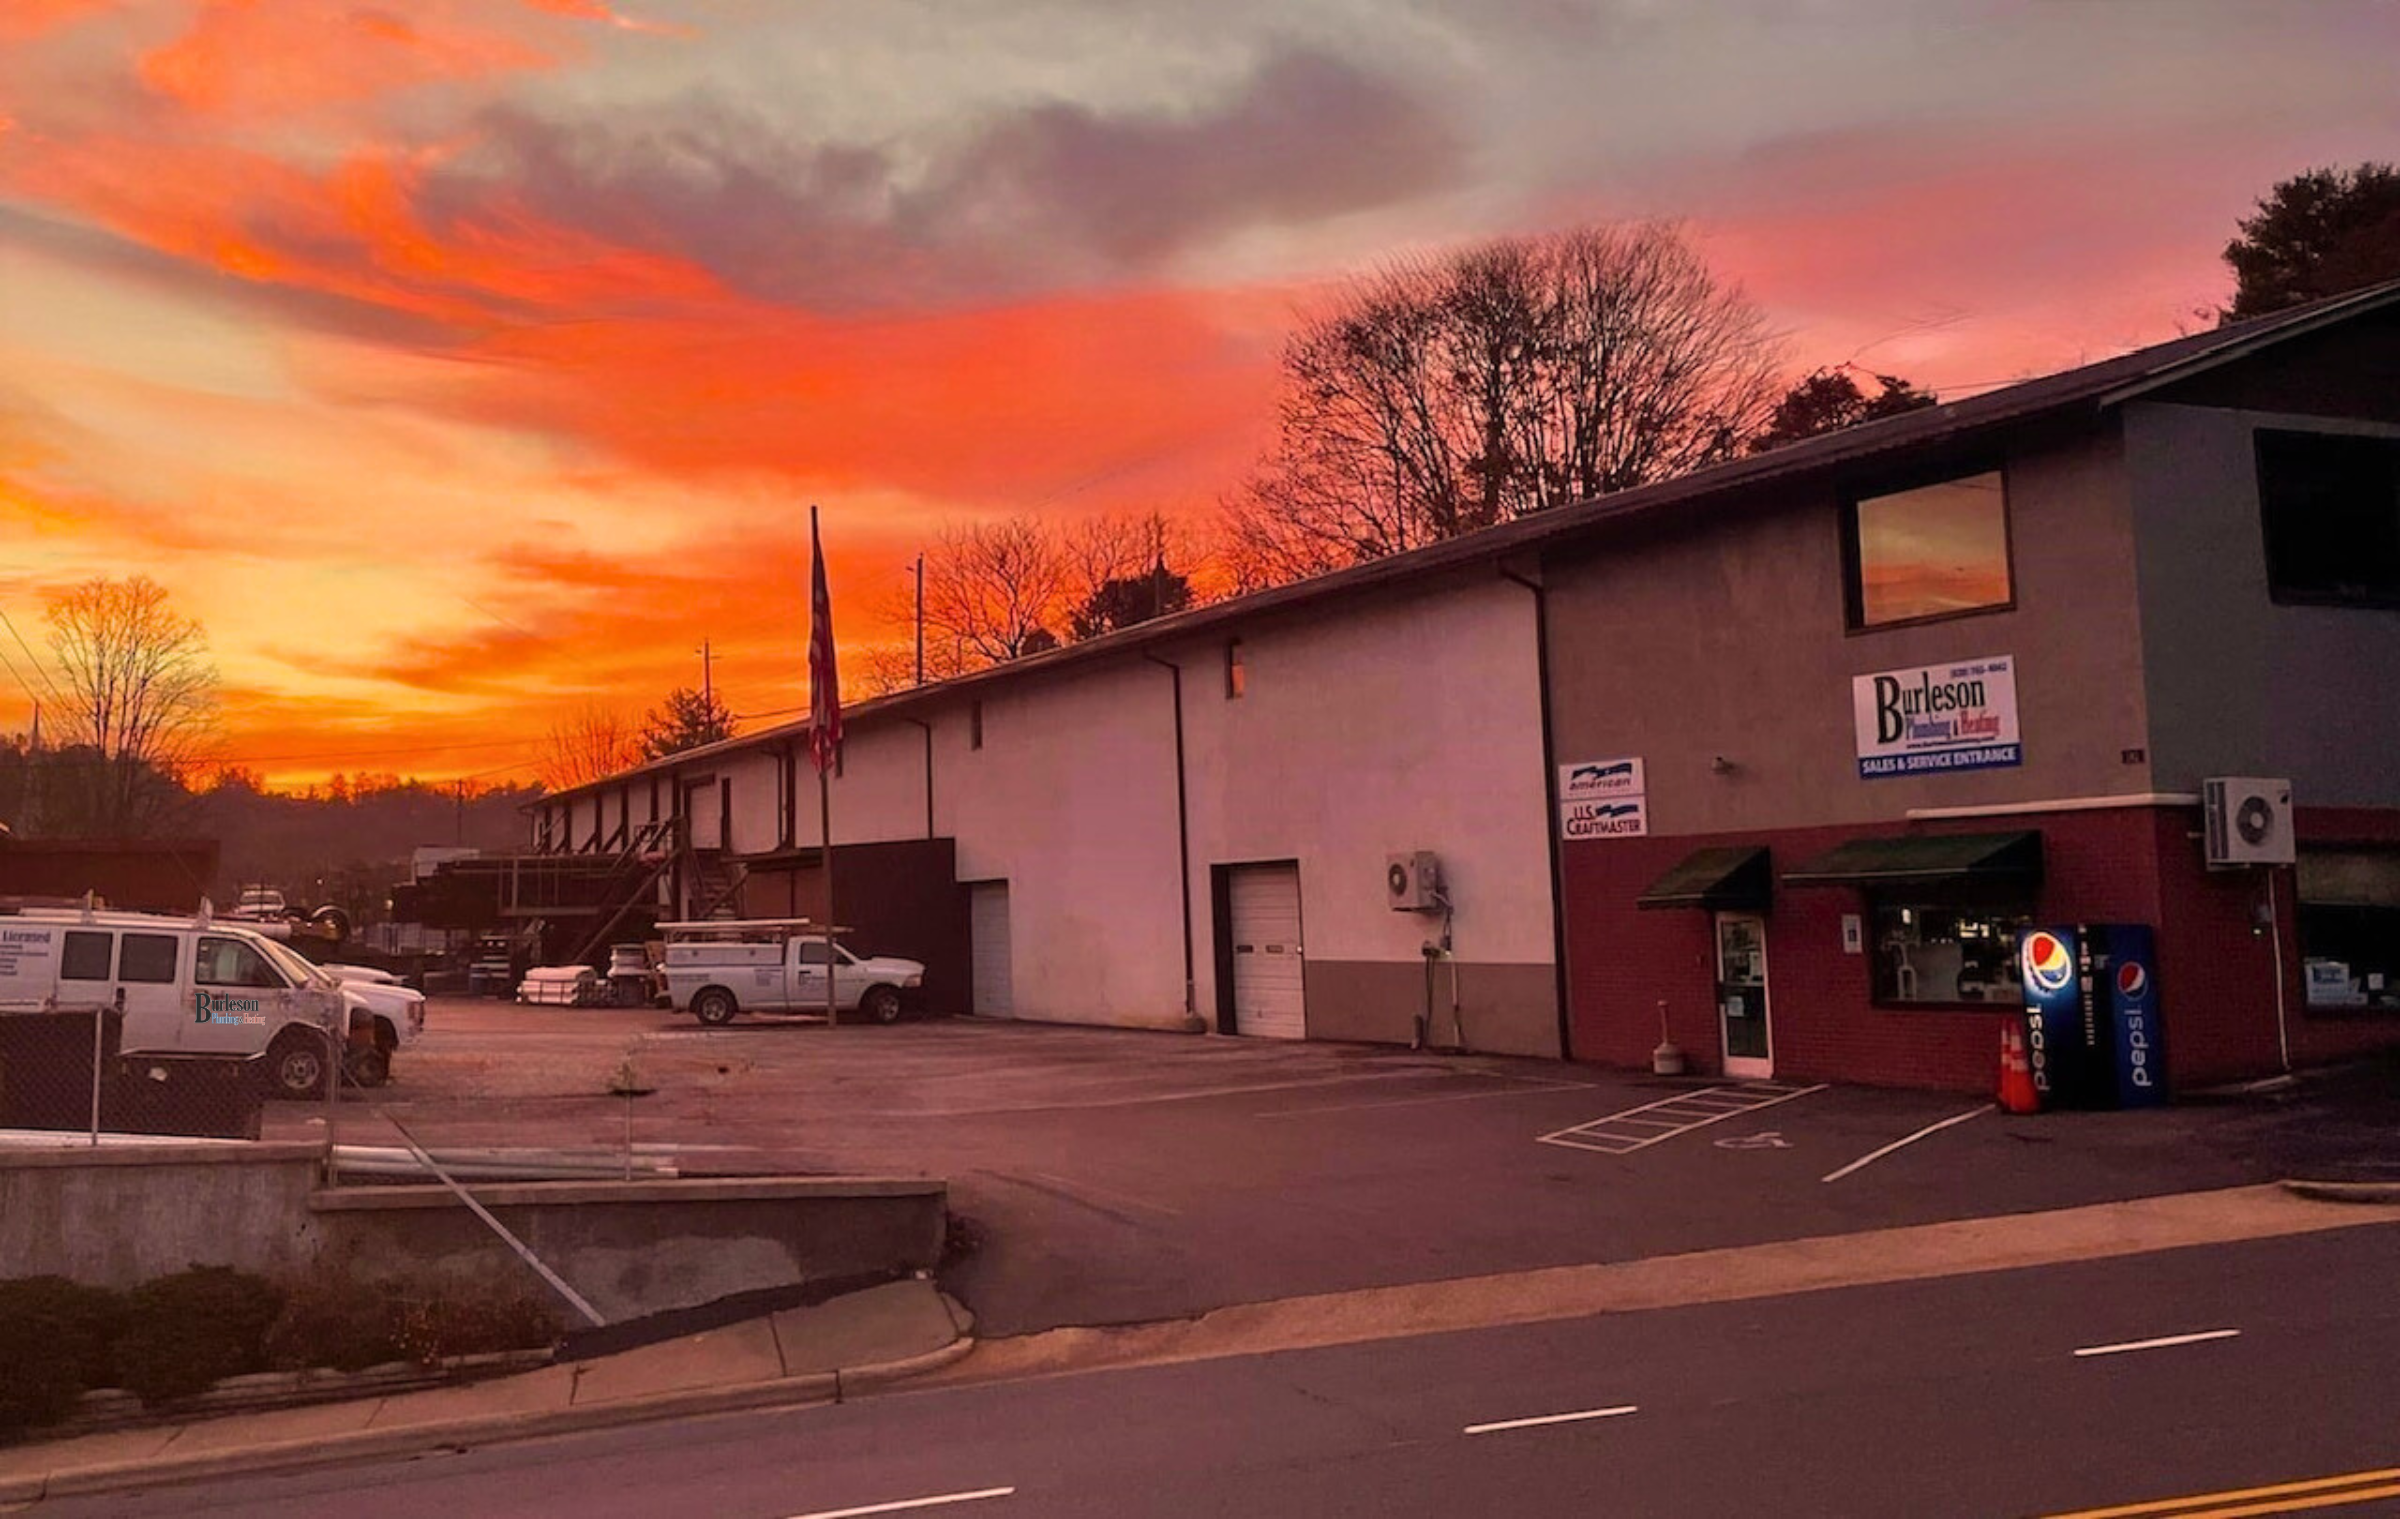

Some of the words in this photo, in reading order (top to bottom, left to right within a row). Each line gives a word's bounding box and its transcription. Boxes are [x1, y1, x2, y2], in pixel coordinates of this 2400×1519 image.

[1873, 671, 1985, 744] Burleson
[1862, 757, 1897, 774] SALES
[1897, 756, 1906, 771] &
[1907, 753, 1952, 769] SERVICE
[1953, 747, 2016, 766] ENTRANCE
[195, 993, 259, 1023] Burleson
[211, 1012, 239, 1026] Plumbing
[243, 1012, 266, 1026] Heating
[2124, 1003, 2152, 1087] pepsi
